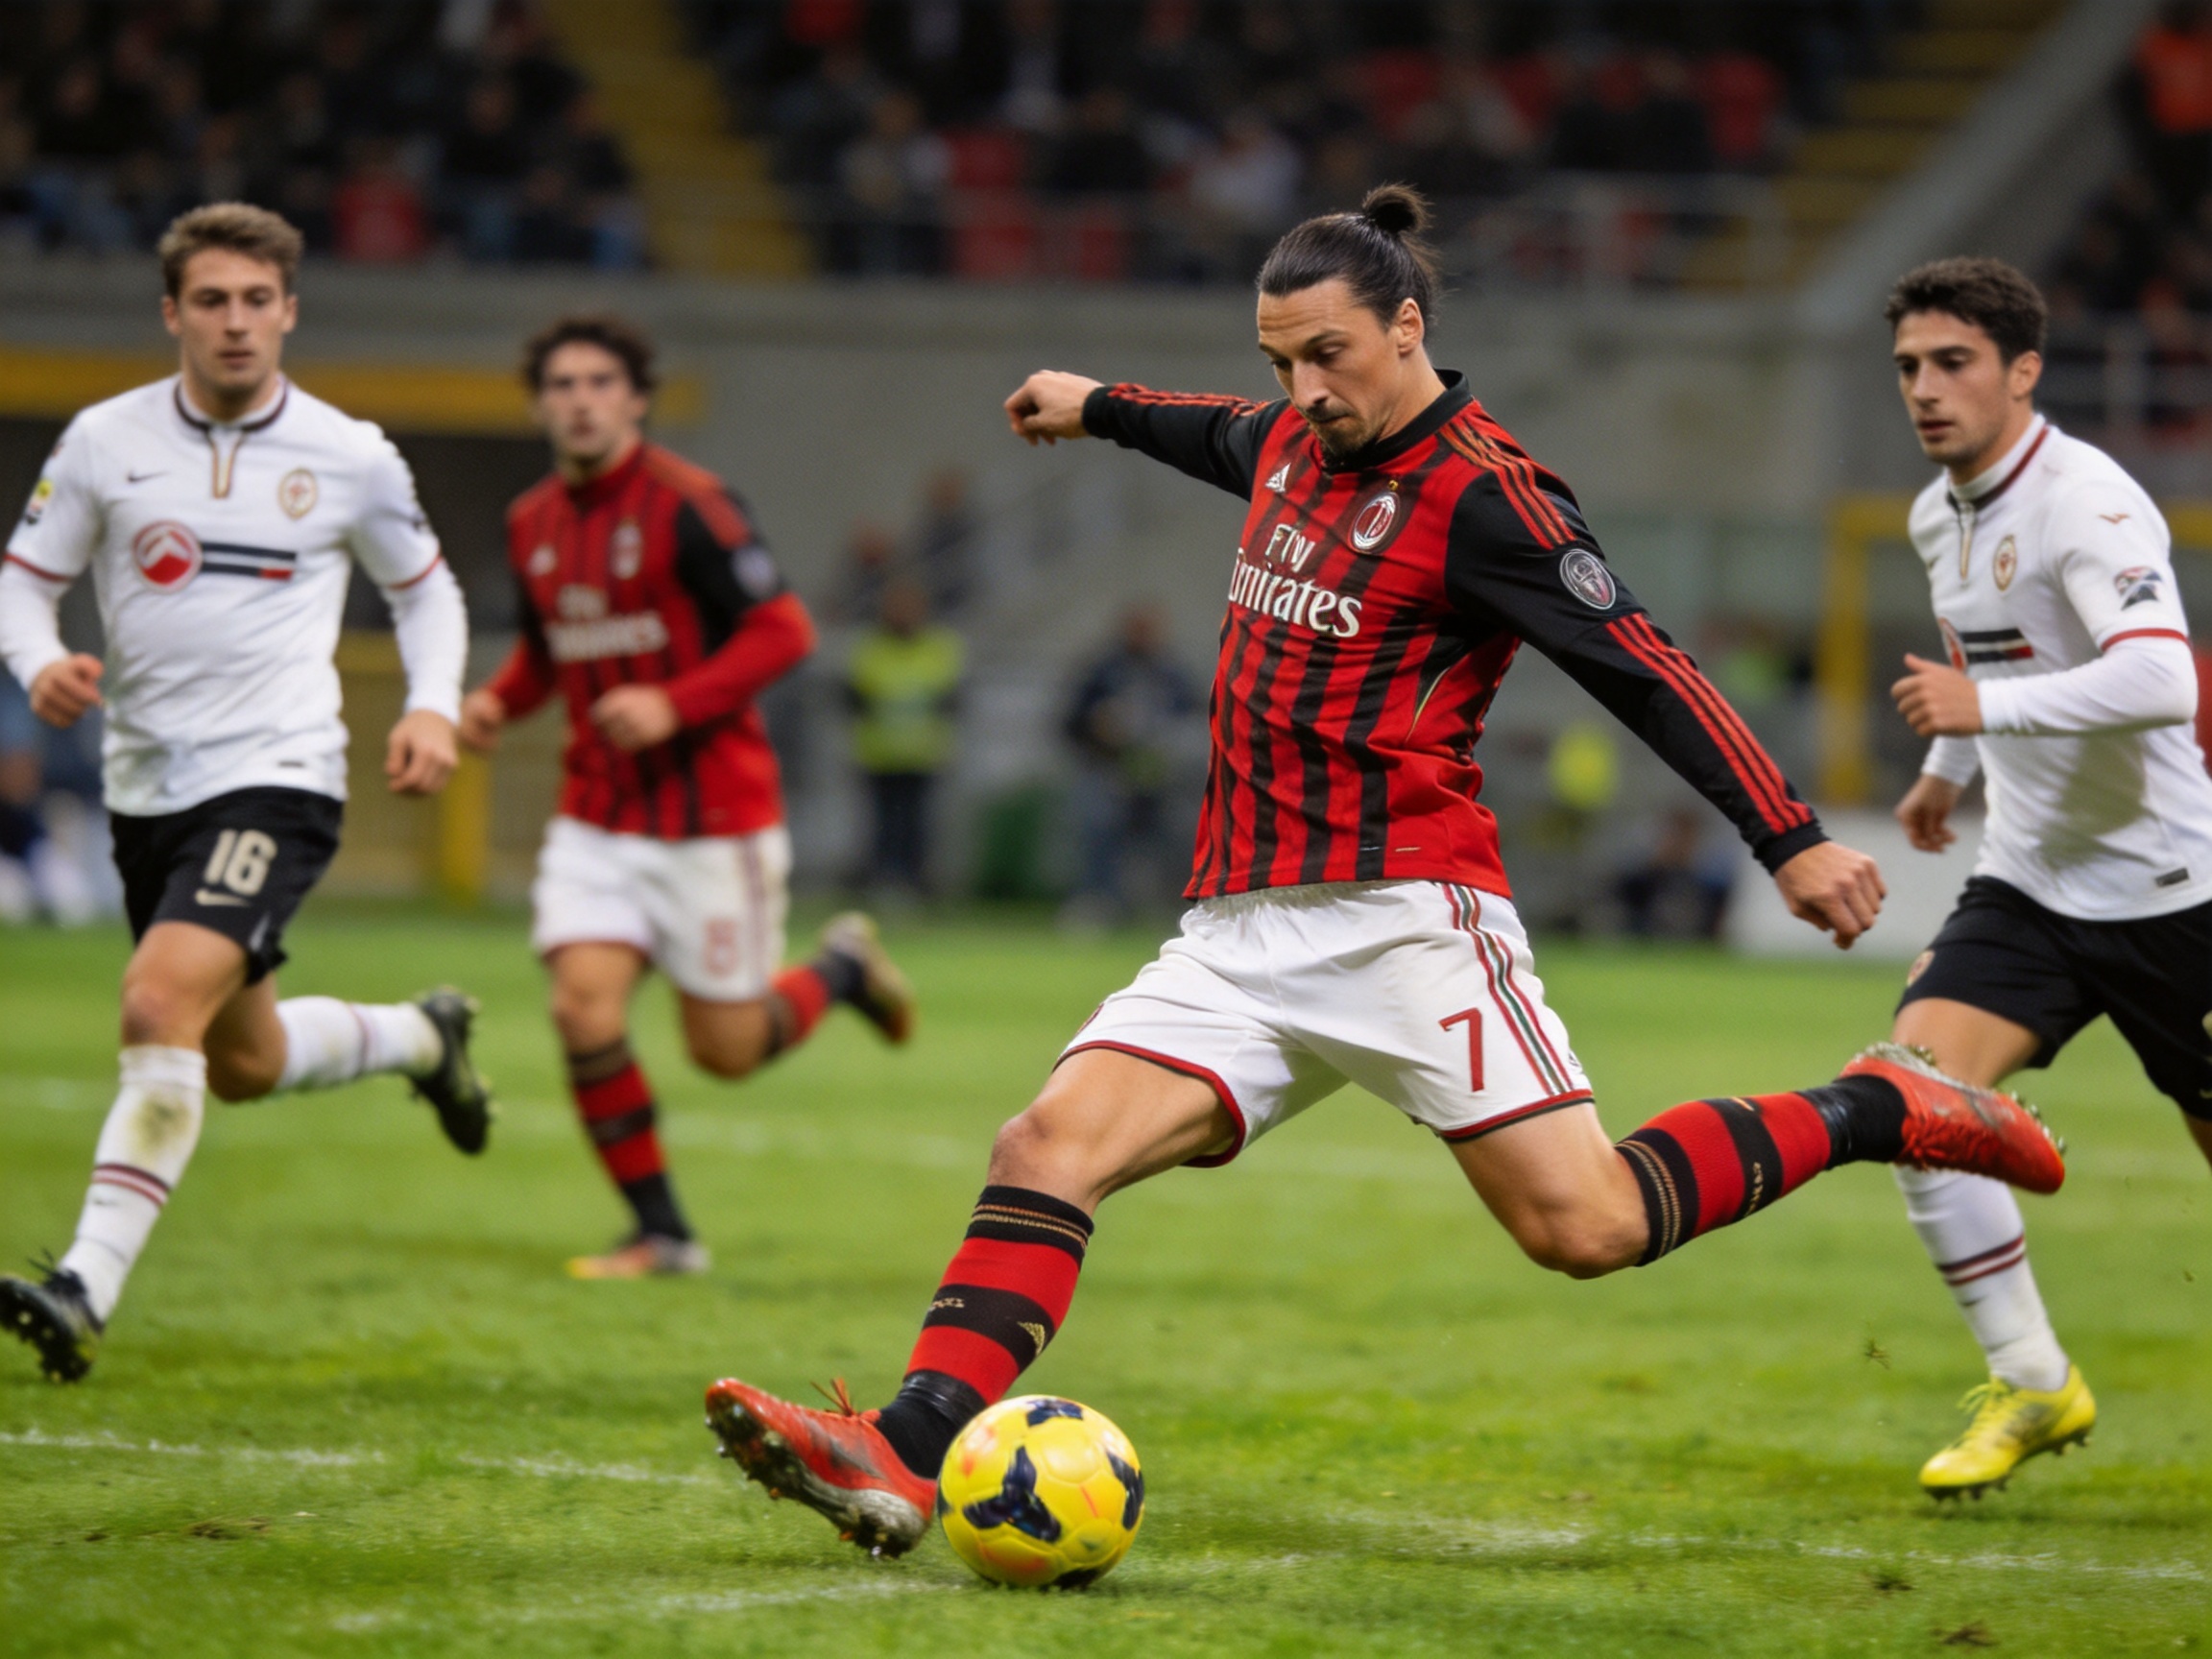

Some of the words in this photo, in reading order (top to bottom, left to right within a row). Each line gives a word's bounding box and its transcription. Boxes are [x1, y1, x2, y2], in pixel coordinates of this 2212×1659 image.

[1264, 522, 1315, 573] Fly
[204, 829, 277, 896] 16
[1438, 1006, 1484, 1093] 7
